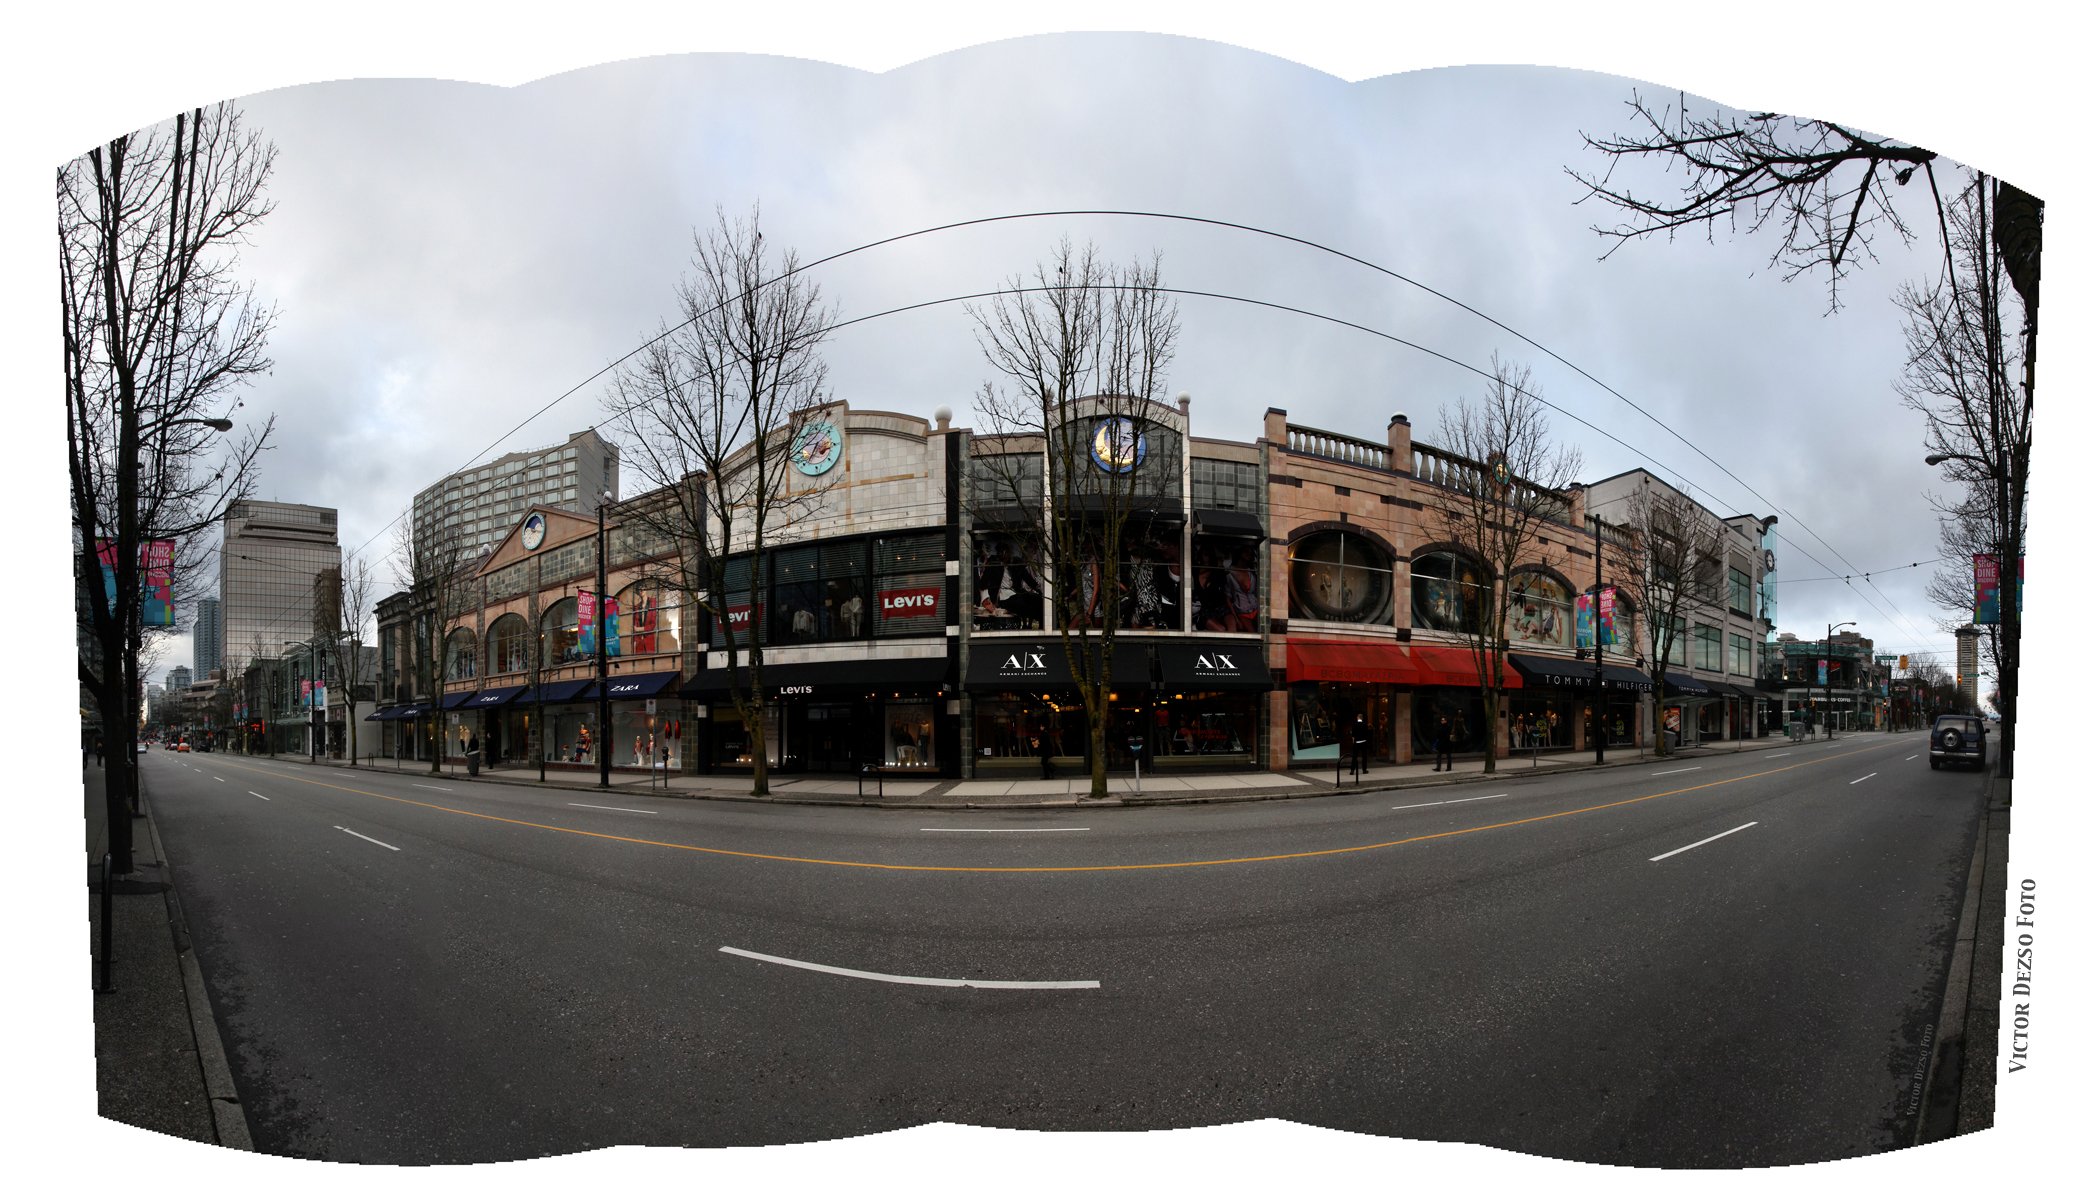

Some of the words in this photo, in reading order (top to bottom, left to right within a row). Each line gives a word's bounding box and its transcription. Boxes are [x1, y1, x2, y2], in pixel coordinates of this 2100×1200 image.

[1977, 568, 1996, 577] DINE
[1545, 674, 1591, 686] TOMMY
[1616, 680, 1653, 692] HILFIGER
[610, 684, 640, 692] ZARA
